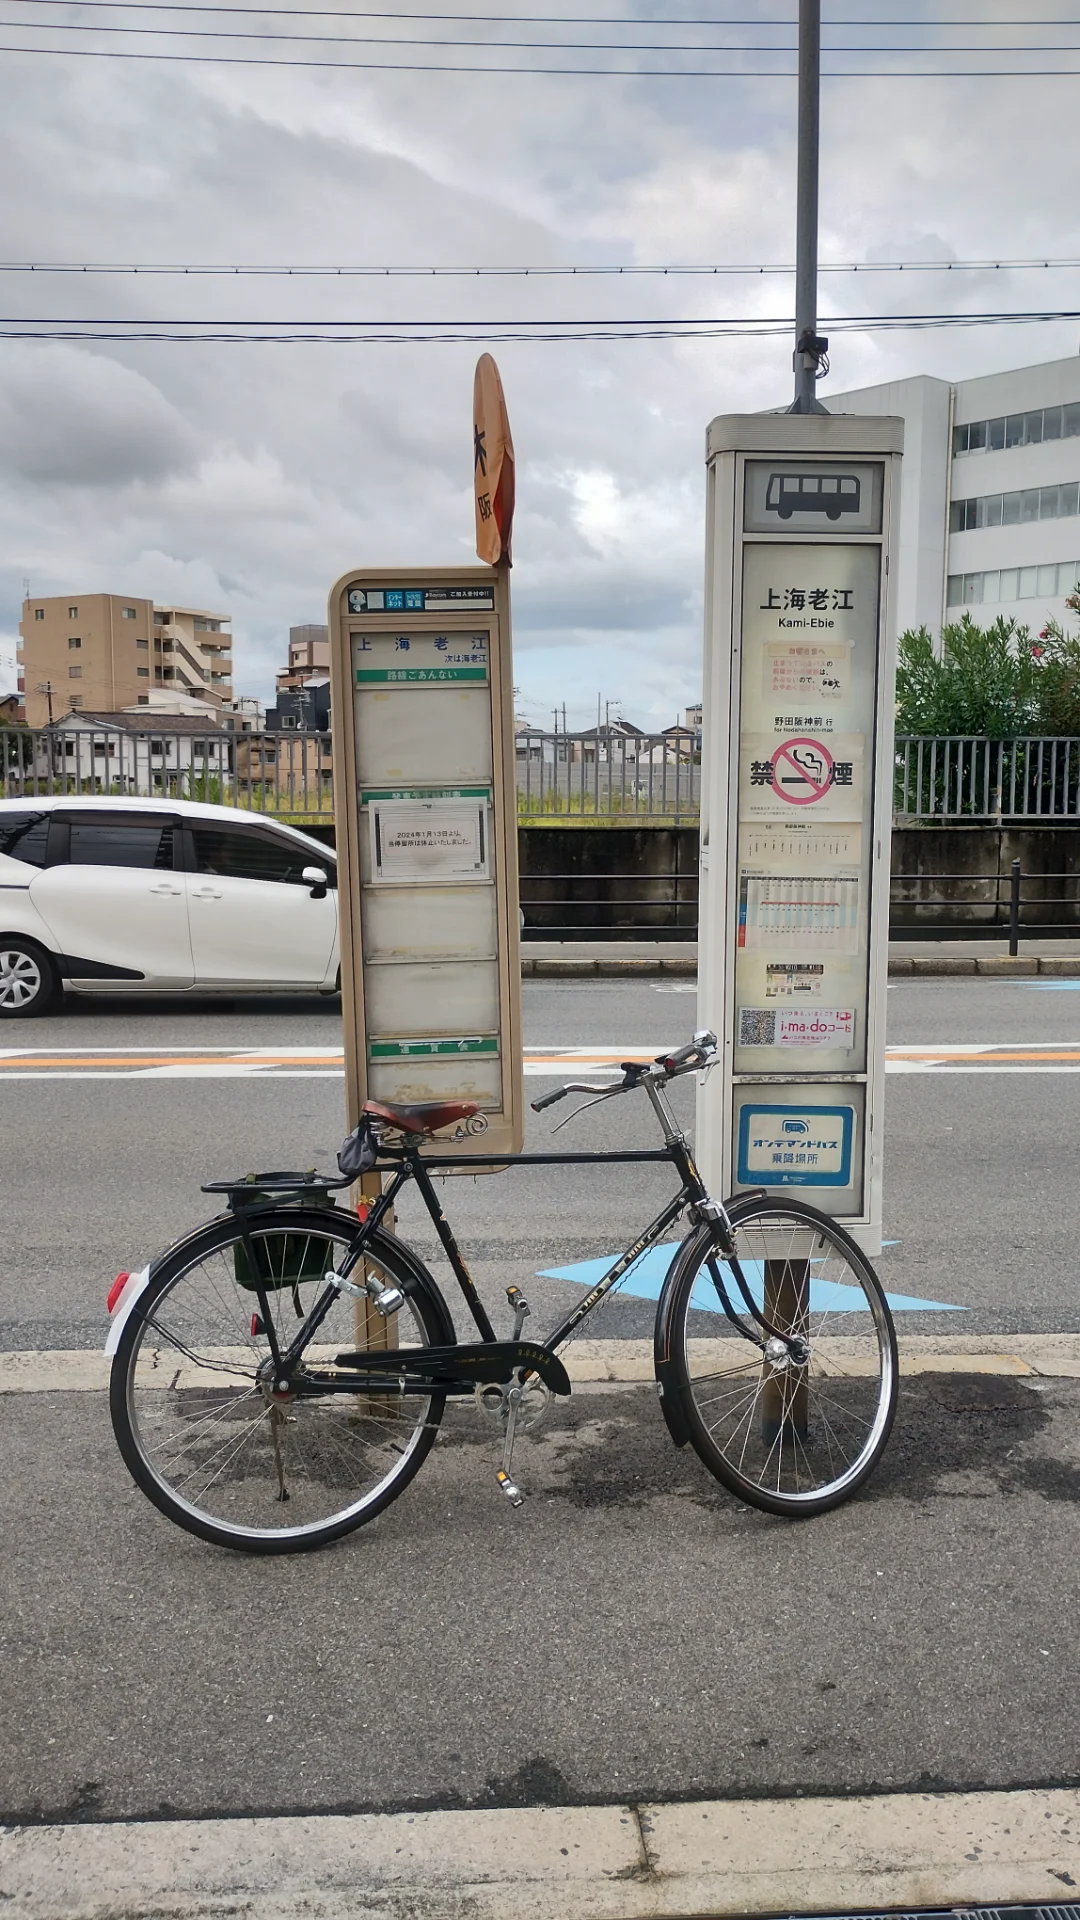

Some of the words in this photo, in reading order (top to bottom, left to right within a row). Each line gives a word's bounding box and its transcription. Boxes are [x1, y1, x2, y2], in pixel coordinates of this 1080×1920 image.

[760, 588, 854, 611] 上海老江
[778, 618, 835, 628] Kami-Ebie
[357, 637, 487, 652] 上海老江
[445, 654, 487, 663] 次は海老江
[387, 670, 458, 681] 路線ごあんない
[750, 760, 774, 786] 禁
[829, 761, 853, 786] 煙
[388, 839, 472, 847] 当停留所は休止いたしました。
